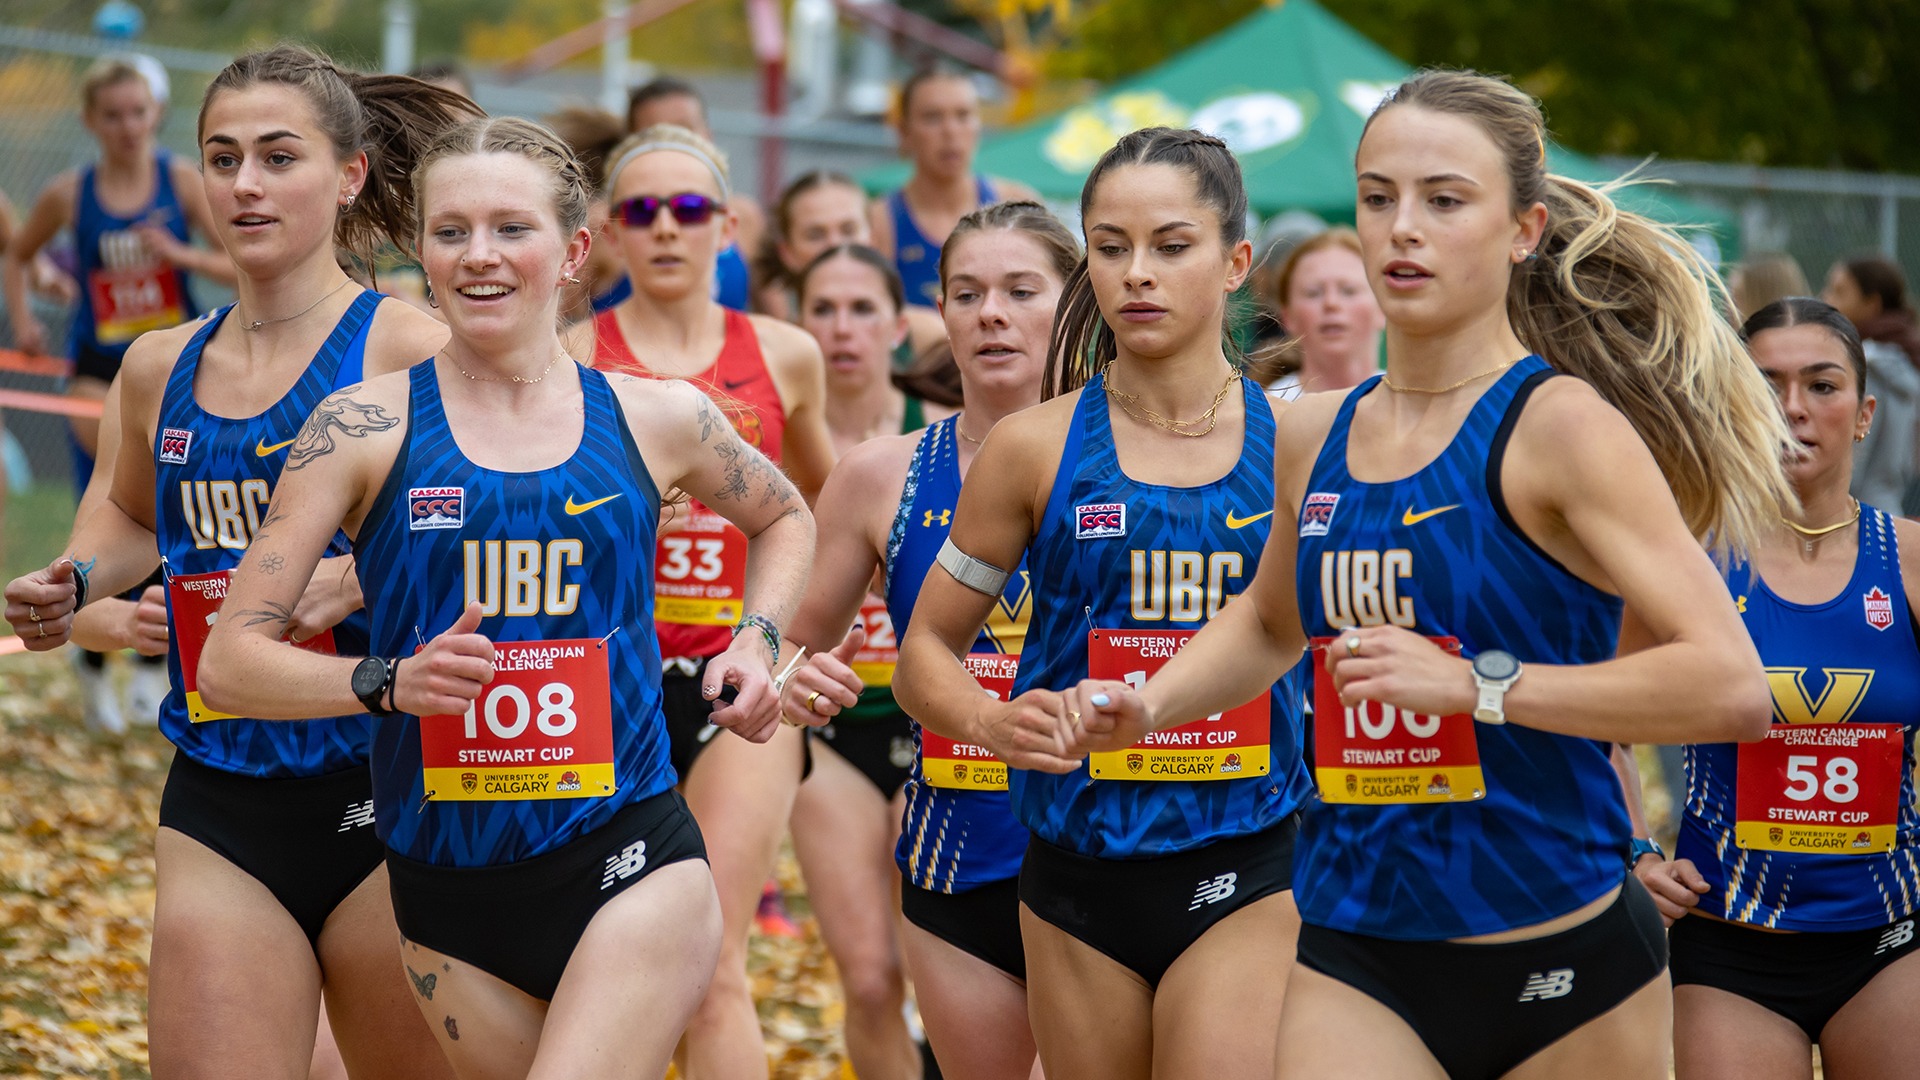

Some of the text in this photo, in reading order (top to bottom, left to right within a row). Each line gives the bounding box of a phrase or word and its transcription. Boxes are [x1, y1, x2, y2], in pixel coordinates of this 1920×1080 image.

[410, 489, 462, 497] CASCADE
[412, 498, 460, 517] CCC
[1078, 504, 1122, 513] CASCADE
[180, 479, 271, 550] UBC
[1081, 513, 1121, 528] CCC
[660, 537, 725, 581] 33
[463, 538, 584, 617] UBC
[181, 577, 227, 592] WESTERN
[1130, 550, 1243, 622] UBC
[1321, 548, 1416, 631] UBC
[1868, 611, 1891, 622] WEST
[1108, 636, 1176, 648] WESTERN
[508, 646, 585, 661] CANADIAN
[491, 658, 553, 672] ALLENGE
[967, 667, 1018, 679] CHALLE
[463, 682, 578, 740] 108
[1137, 731, 1237, 745] EWART CUP
[1764, 728, 1887, 740] ESTERN CANADIAN
[1784, 736, 1859, 747] CHALLENGE
[458, 747, 574, 763] STEWART CUP
[952, 744, 994, 757] STEW
[1343, 748, 1441, 764] STEWART CUP
[1150, 763, 1215, 775] CALGARY
[1220, 764, 1242, 773] DINOS
[973, 774, 1008, 784] CALG
[1783, 755, 1860, 804] 58
[484, 781, 550, 794] CALGARY
[556, 783, 581, 792] DINOS
[1362, 785, 1421, 797] CALGARY
[1768, 807, 1870, 823] STEWART CUP
[1789, 830, 1835, 838] UNIVERSITY
[1789, 838, 1848, 849] CALGARY
